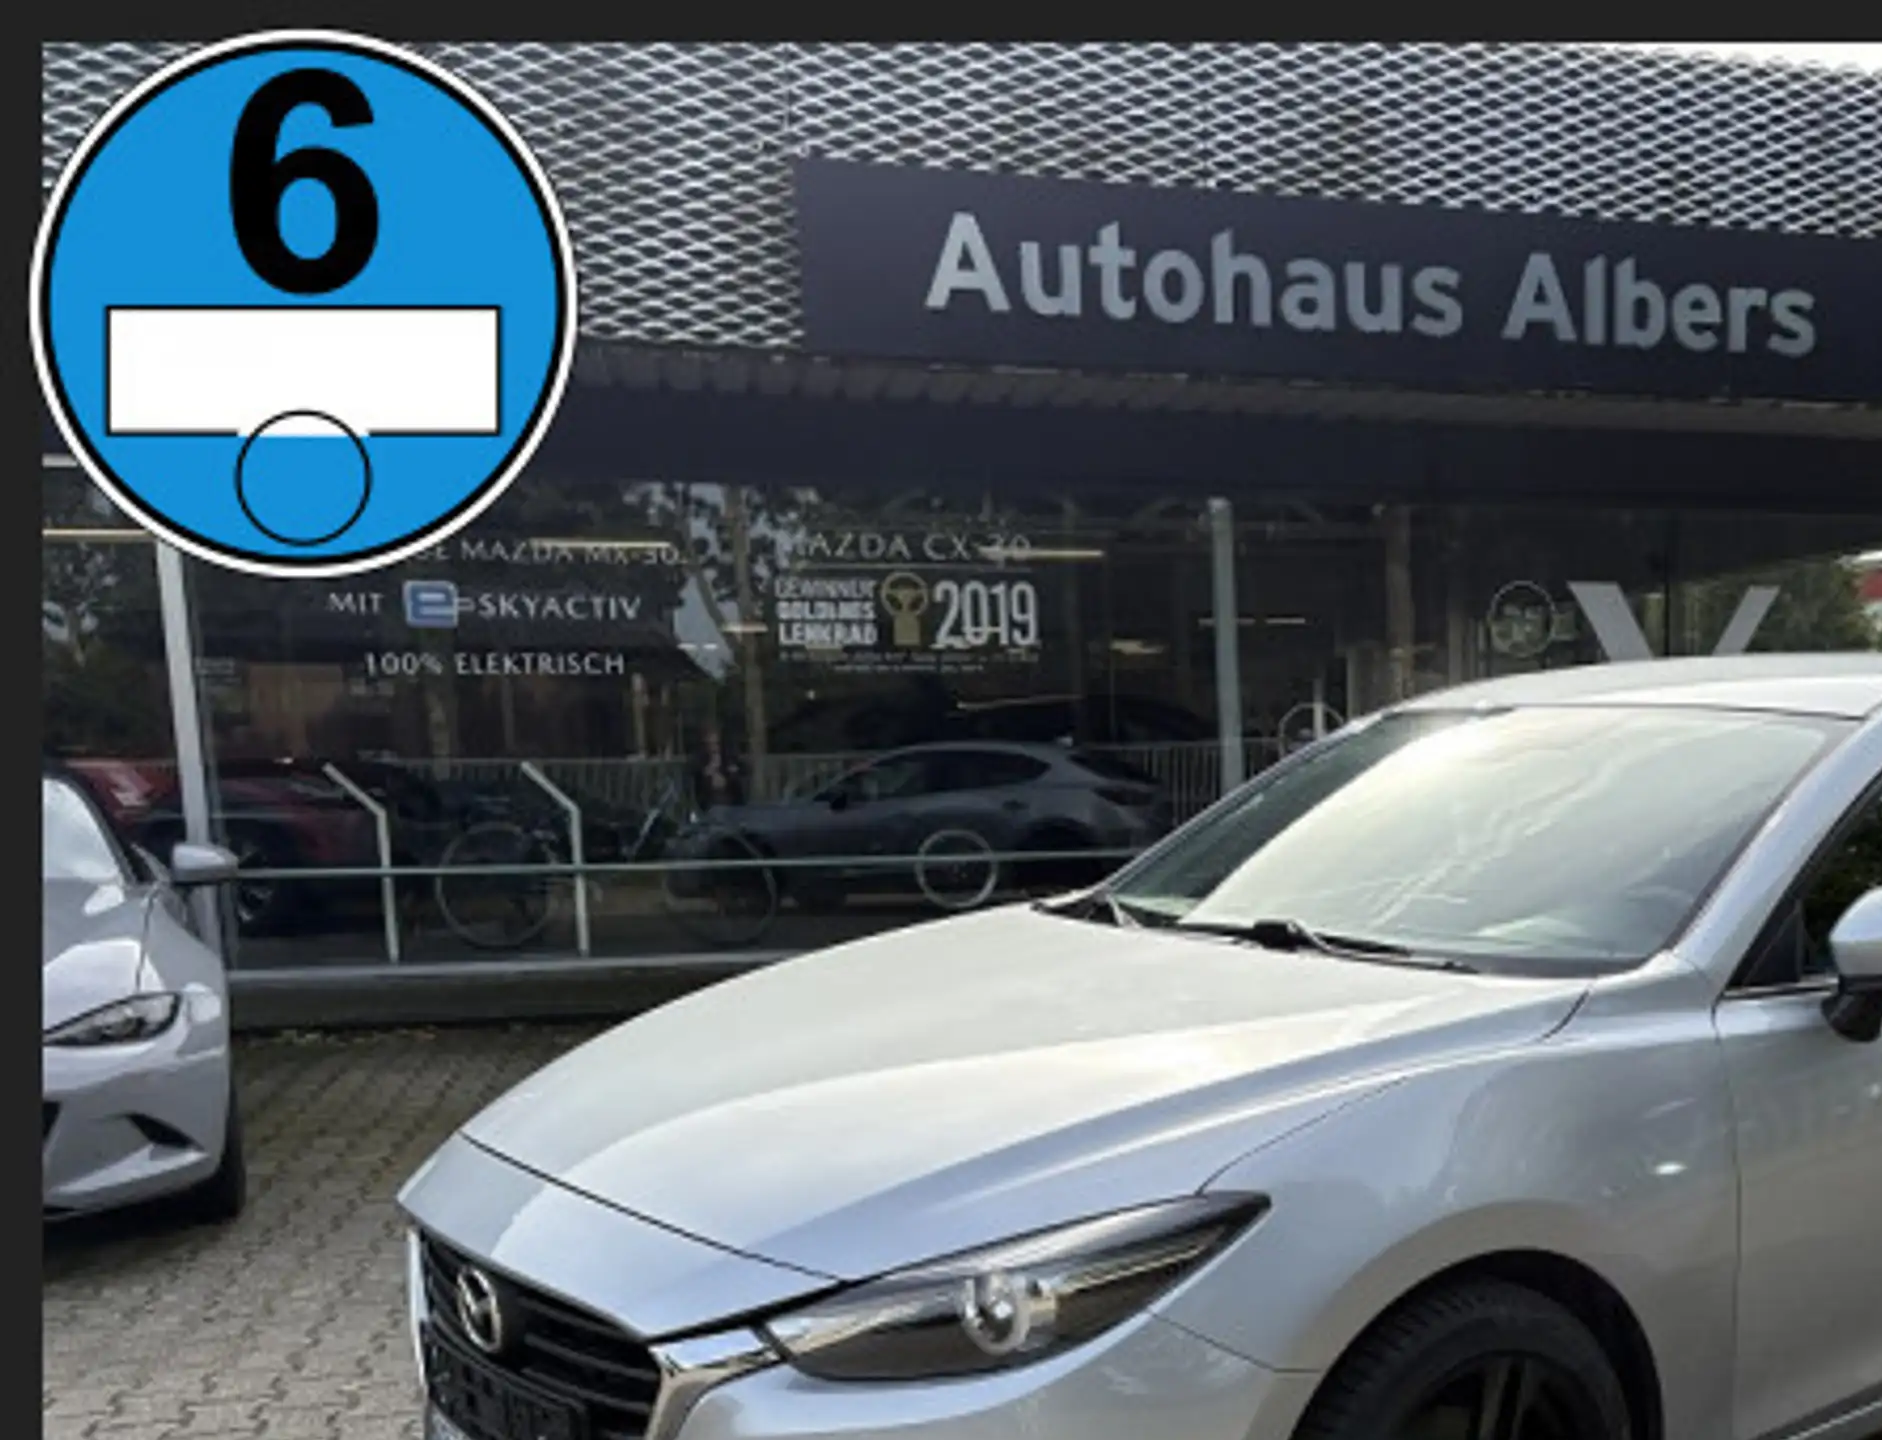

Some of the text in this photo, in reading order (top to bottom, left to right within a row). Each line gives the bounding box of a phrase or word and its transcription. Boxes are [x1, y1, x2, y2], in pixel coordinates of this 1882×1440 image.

[925, 211, 1818, 358] Autohaus Albers
[460, 539, 573, 564] MAZDA
[328, 593, 384, 613] MIT
[934, 580, 1039, 647] 2019
[366, 653, 625, 676] 100% ELEKTRISCH
